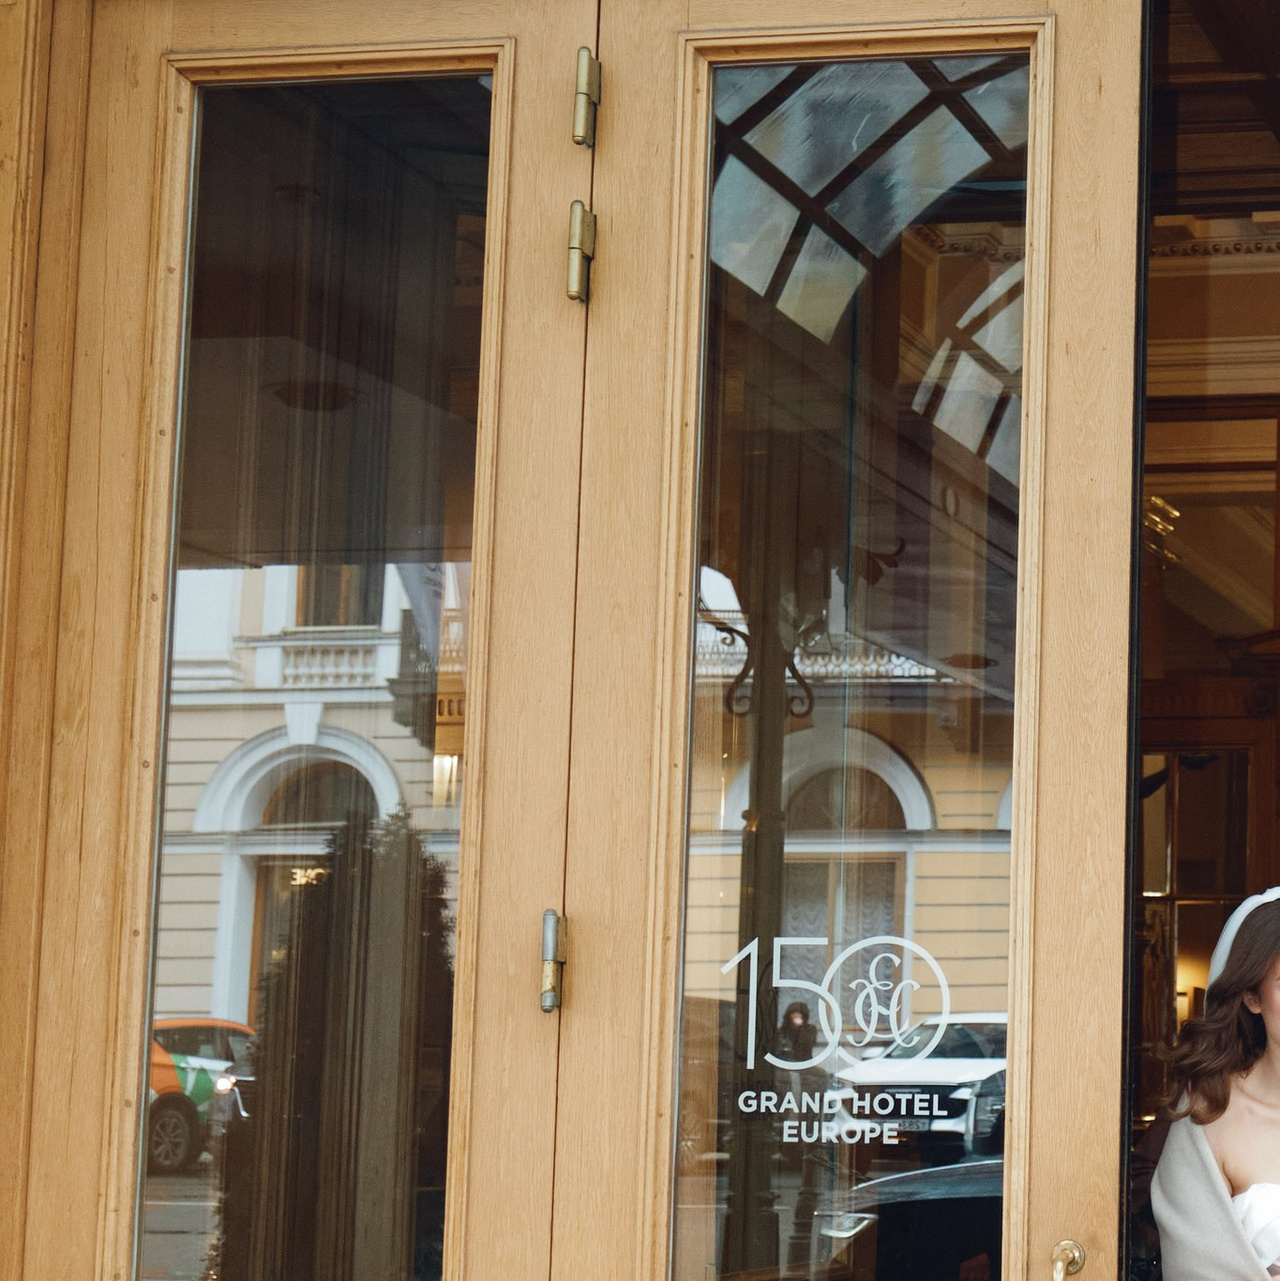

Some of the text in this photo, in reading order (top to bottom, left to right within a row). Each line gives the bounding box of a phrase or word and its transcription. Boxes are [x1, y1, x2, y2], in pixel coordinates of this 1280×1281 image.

[720, 936, 950, 1070] 150
[738, 1091, 948, 1116] GRAND HOTEL
[782, 1121, 899, 1145] EUROPE
